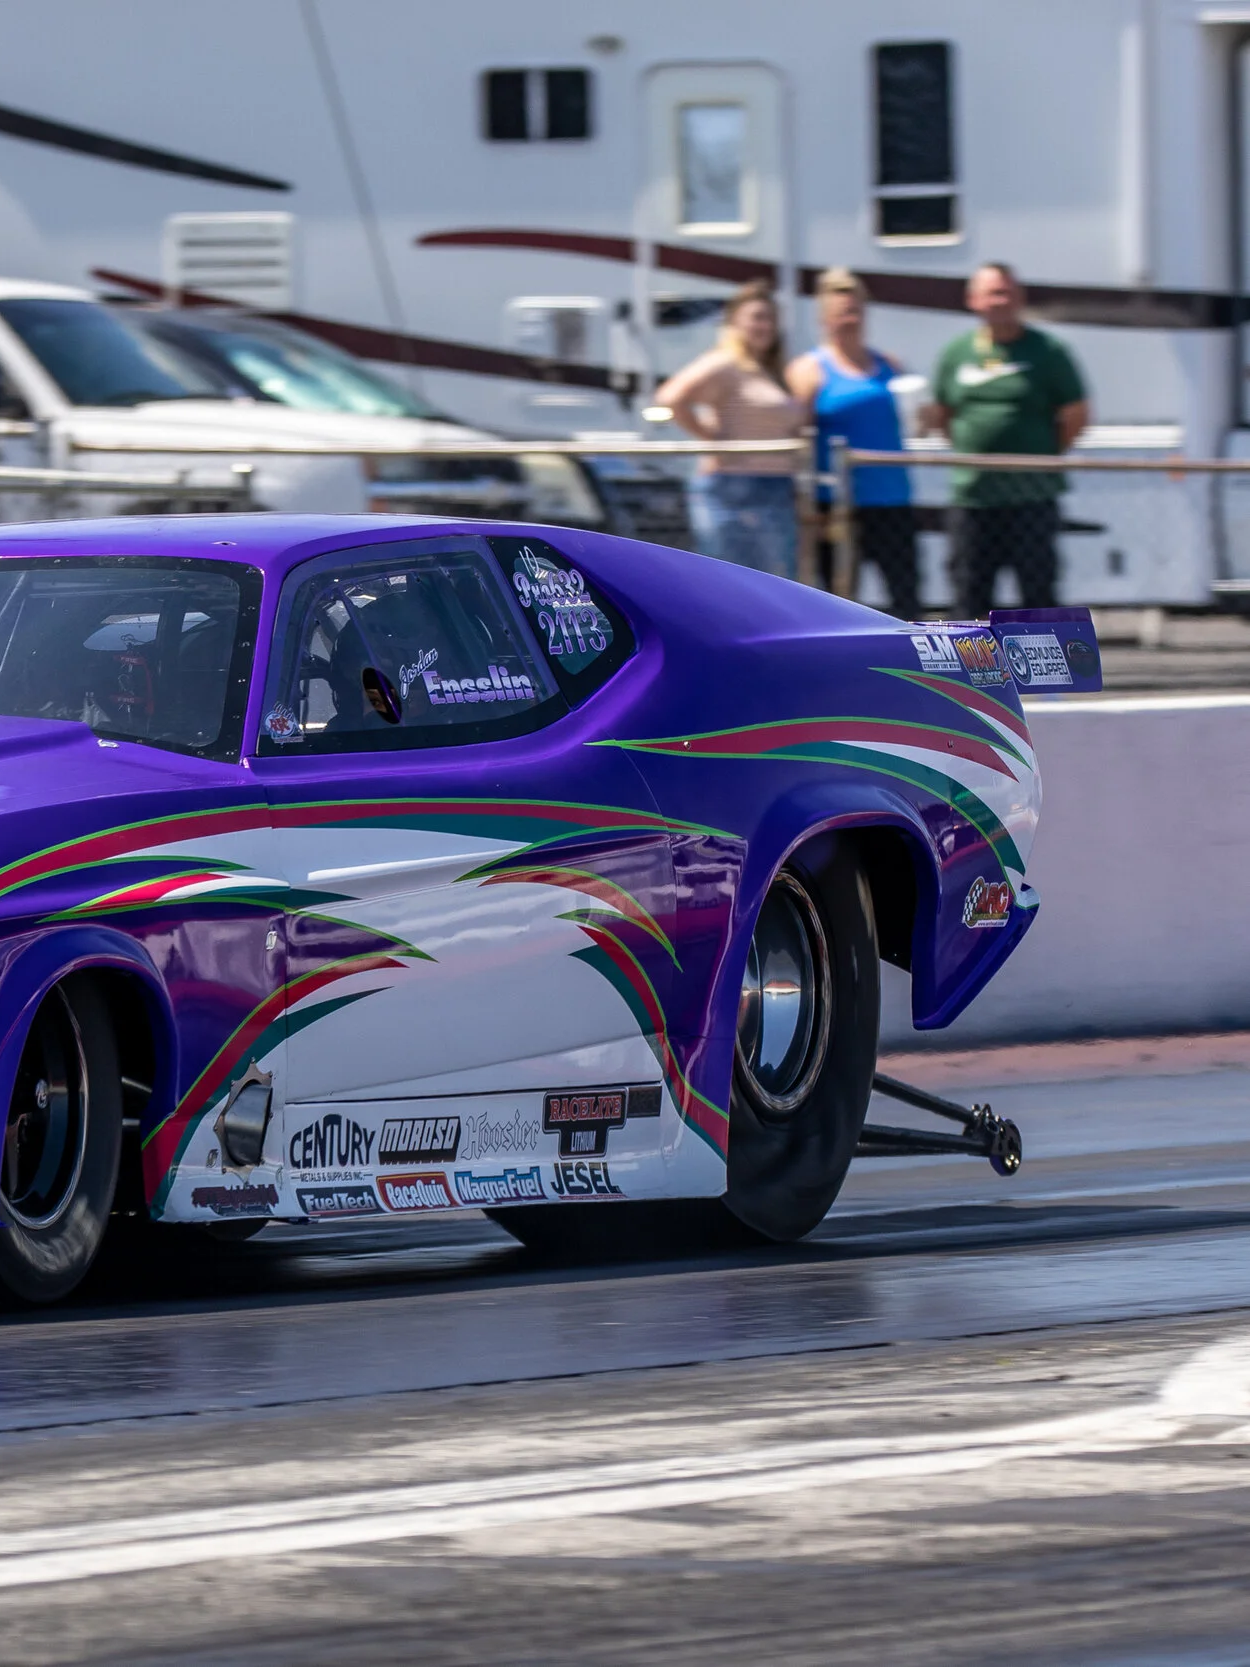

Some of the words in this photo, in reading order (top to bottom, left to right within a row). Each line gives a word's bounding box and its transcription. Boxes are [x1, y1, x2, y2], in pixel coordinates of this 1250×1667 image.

[538, 610, 607, 655] 2113
[910, 635, 959, 661] SLM
[1024, 646, 1064, 660] EDMUNDS
[1031, 662, 1068, 676] EQUIPPED
[399, 648, 438, 699] Jordan
[422, 665, 535, 705] Ensslin
[289, 1113, 376, 1169] CENTURY
[380, 1118, 461, 1152] MOROSO
[461, 1109, 540, 1160] Hoosier
[570, 1131, 597, 1152] LITHIUM
[300, 1173, 321, 1183] METALS
[327, 1172, 352, 1181] SUPPLIES
[456, 1171, 543, 1203] MagnaFuel
[550, 1162, 622, 1195] JESEL
[302, 1191, 377, 1210] FuelTech
[385, 1179, 451, 1209] RaceQuip
